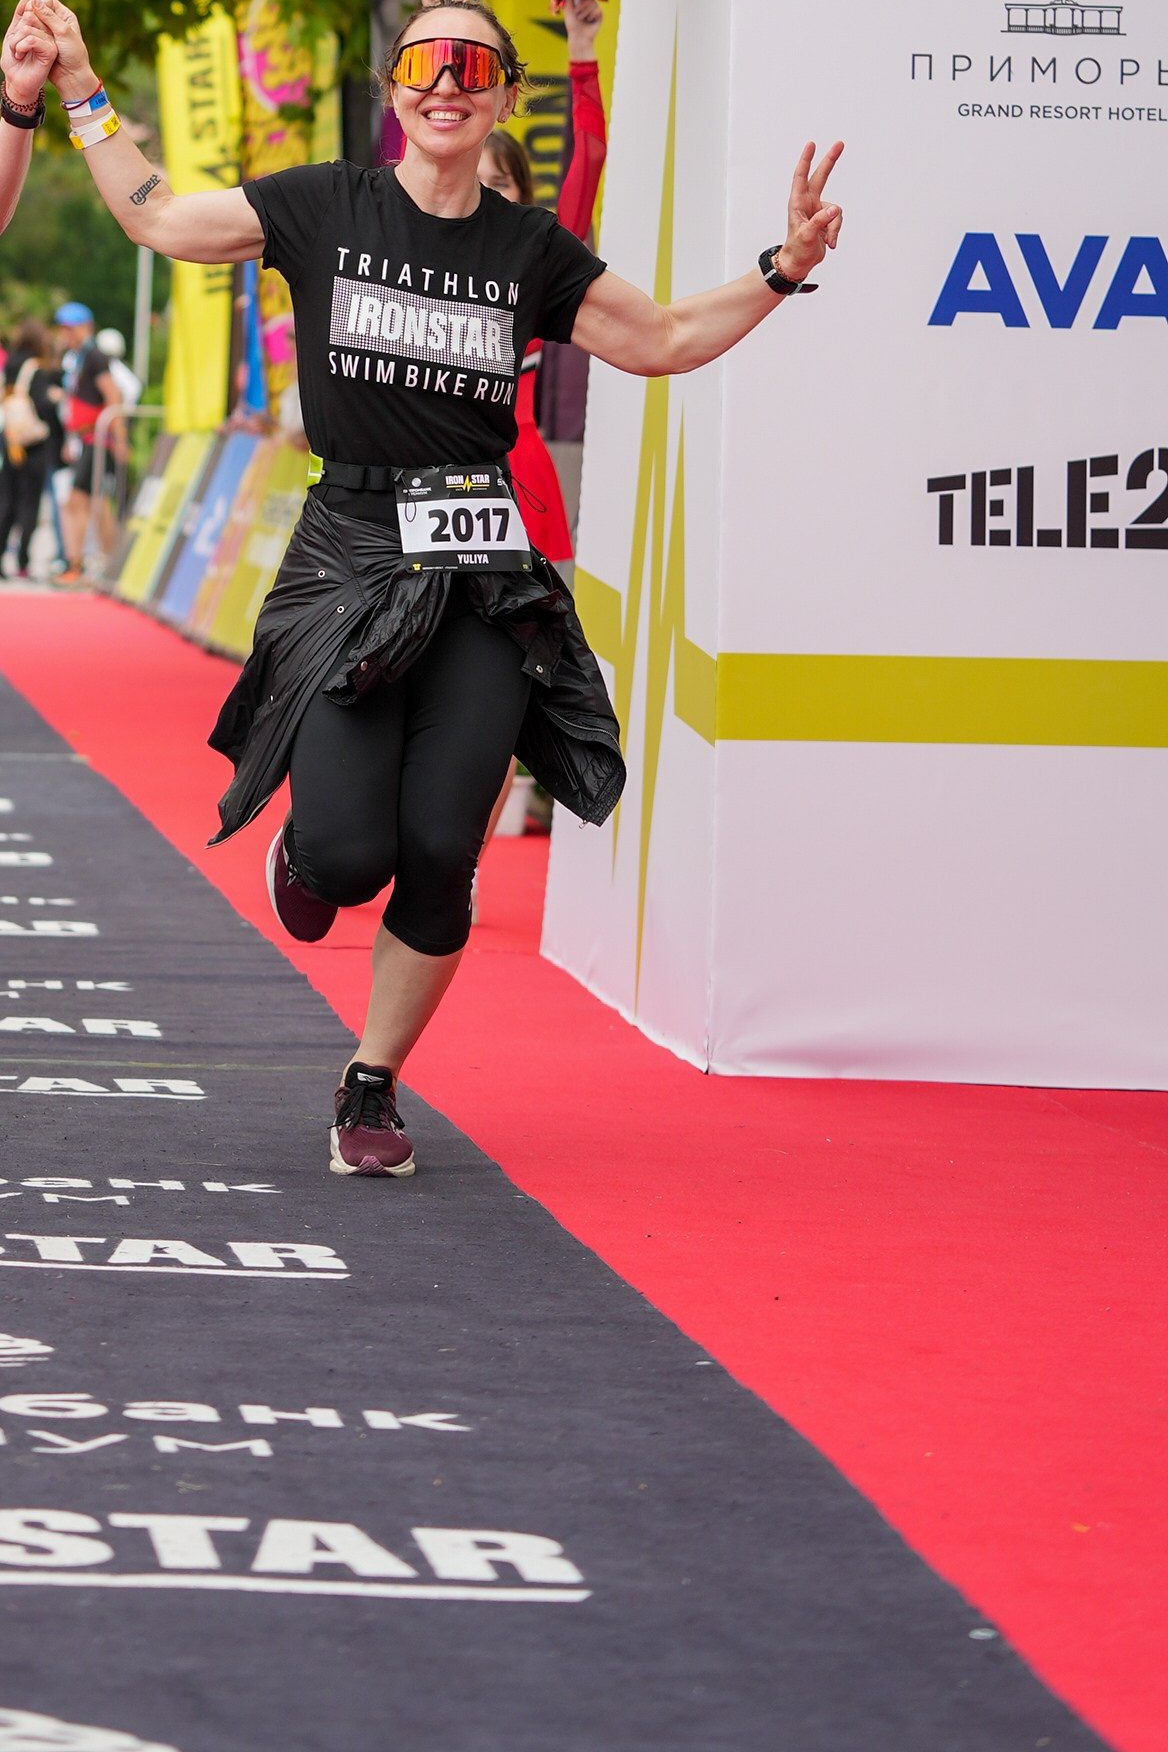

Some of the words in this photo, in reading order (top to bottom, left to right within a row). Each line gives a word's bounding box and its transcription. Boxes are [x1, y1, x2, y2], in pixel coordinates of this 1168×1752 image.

[957, 103, 1023, 118] GRAND
[1030, 105, 1102, 120] RESORT
[1108, 107, 1168, 122] HOTEL
[336, 246, 520, 307] TRIATHLON
[927, 232, 1168, 330] AVA
[346, 293, 502, 362] IRONSTAR
[328, 351, 396, 386] SWIM
[405, 364, 468, 397] BIKE
[473, 377, 515, 406] RUN
[471, 474, 490, 484] STAR
[927, 447, 1168, 550] TELE2
[427, 507, 510, 543] 2017
[457, 553, 490, 565] YULIYA
